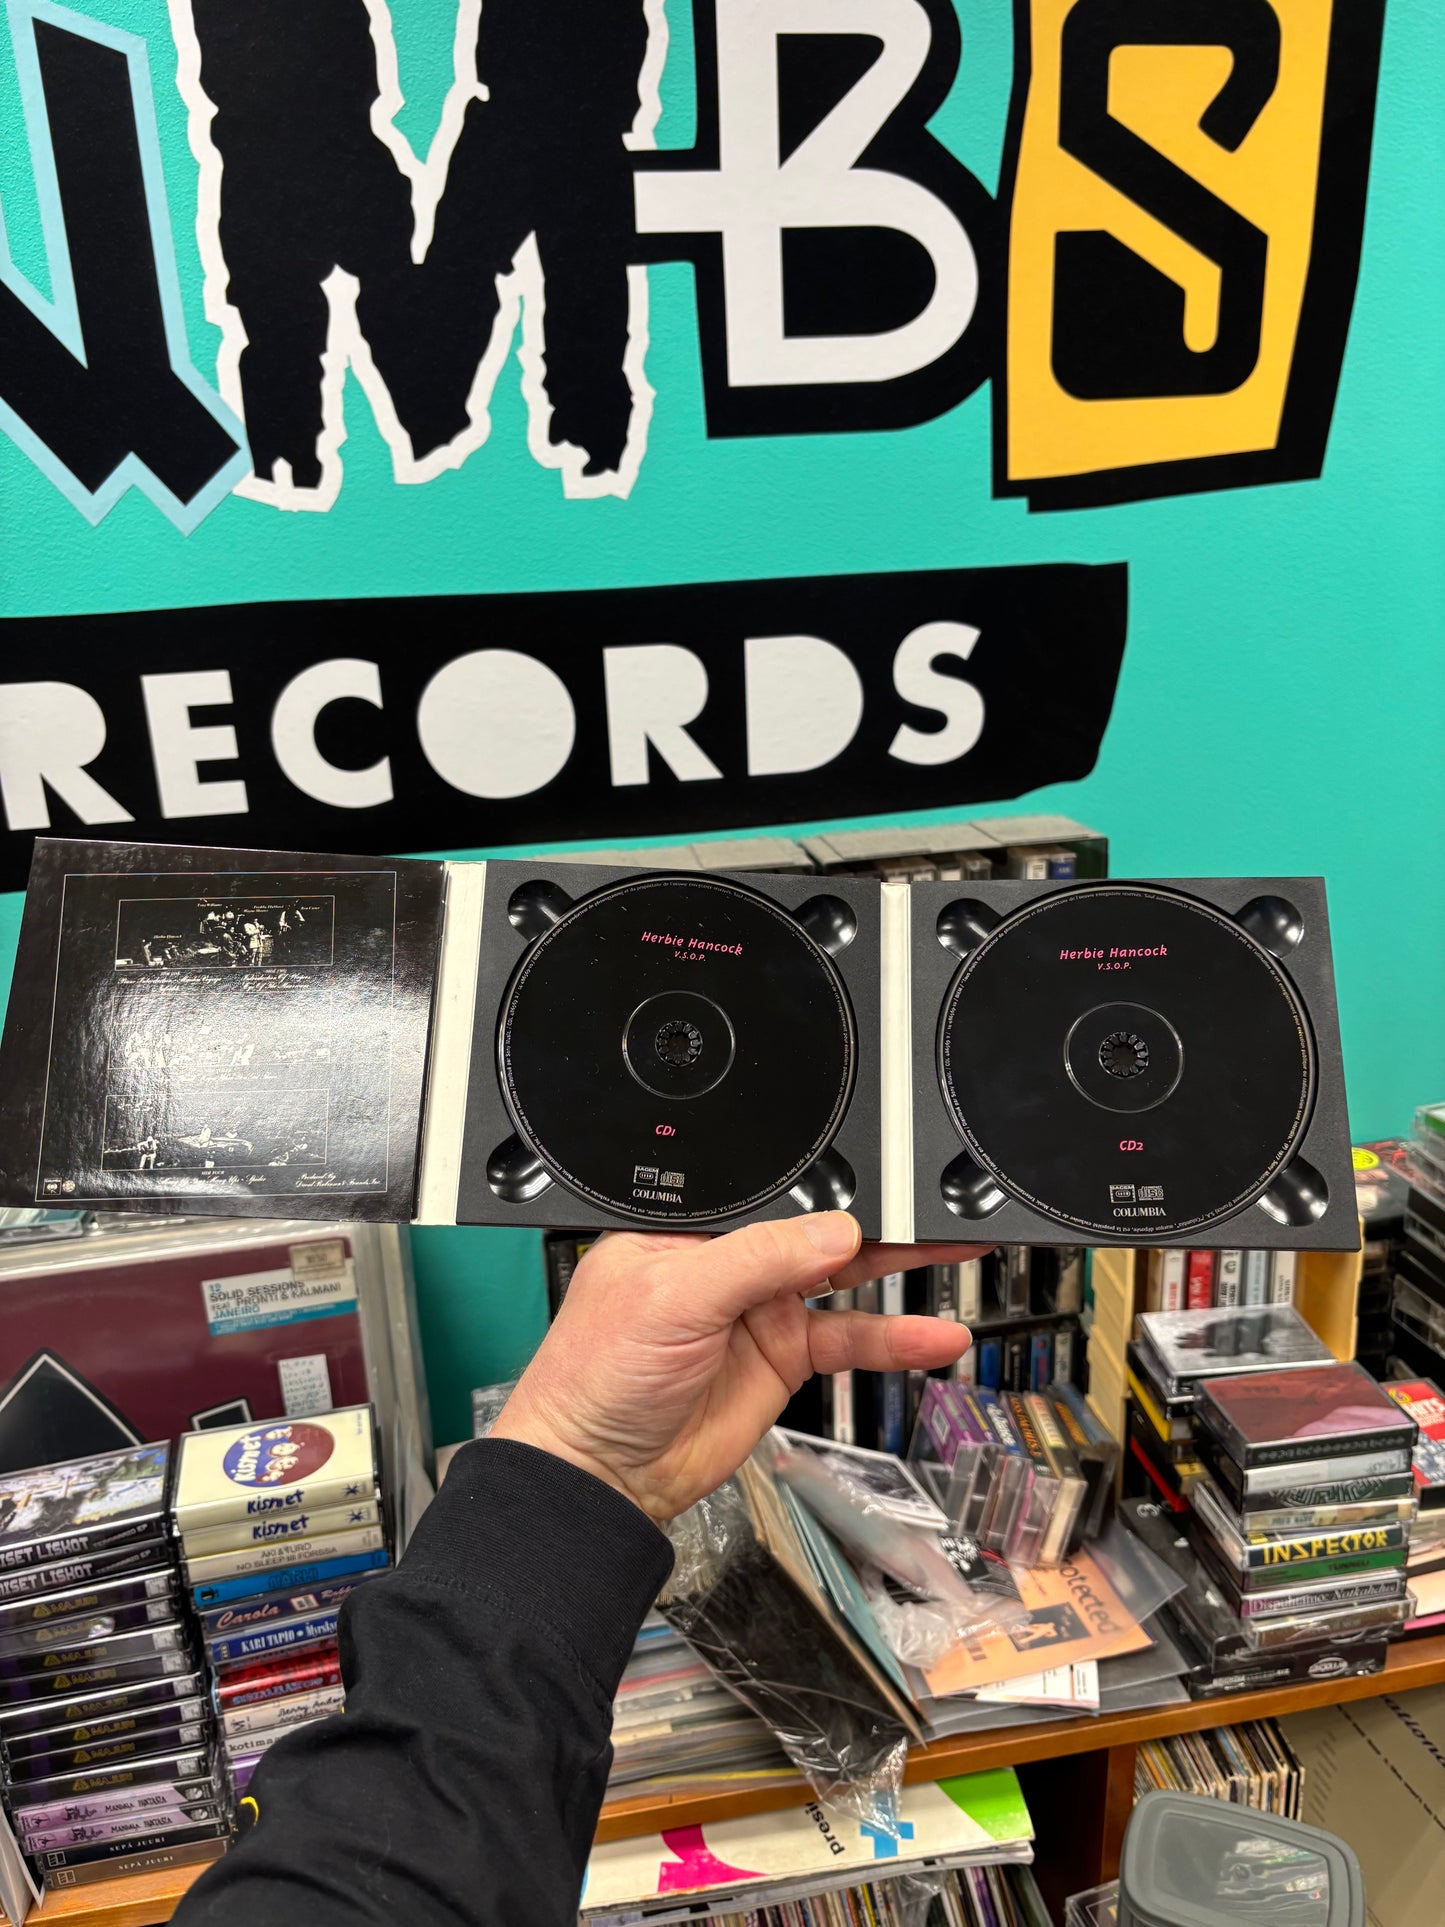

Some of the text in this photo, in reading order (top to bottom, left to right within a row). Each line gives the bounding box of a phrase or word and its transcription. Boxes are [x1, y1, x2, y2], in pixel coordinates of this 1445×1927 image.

[0, 621, 986, 831] RECORDS
[641, 931, 743, 956] Herbie Hancock
[1060, 944, 1168, 960] Herbie Hancock
[1097, 961, 1132, 971] V.S.O.P.
[1119, 1140, 1144, 1151] CD2
[632, 1188, 683, 1204] COLUMBIA
[1113, 1207, 1167, 1217] COLUMBIA
[209, 1289, 245, 1303] SOLID
[213, 1304, 261, 1320] JANEIRO
[36, 1536, 89, 1560] LISKOT
[1262, 1530, 1389, 1565] INSPECTOR
[40, 1562, 93, 1587] LISKOT
[236, 1562, 252, 1571] NO
[215, 1603, 281, 1630] Carola
[241, 1638, 266, 1653] KARI
[266, 1630, 295, 1647] TAPIO
